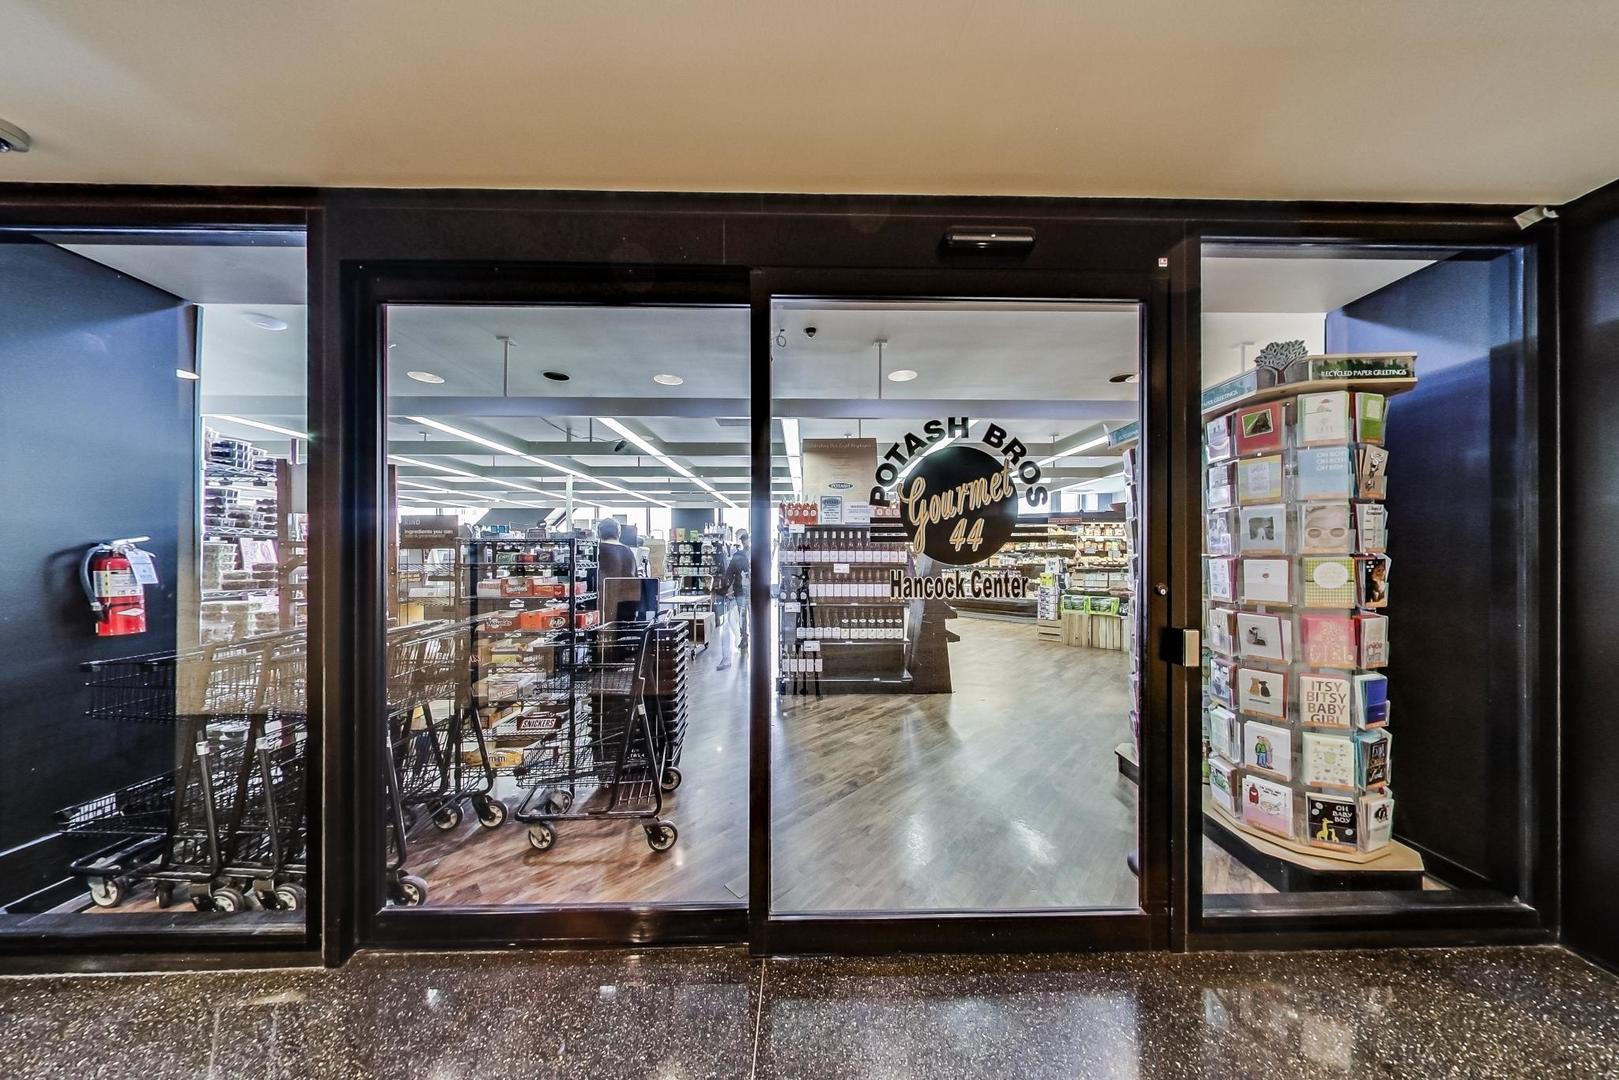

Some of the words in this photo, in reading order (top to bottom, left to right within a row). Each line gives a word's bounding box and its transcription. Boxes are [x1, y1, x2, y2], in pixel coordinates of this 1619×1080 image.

[869, 416, 969, 507] POTASH
[981, 422, 1048, 508] BROS
[897, 456, 1014, 554] Gourmet
[949, 517, 985, 552] 44
[889, 568, 965, 599] Hancock
[970, 569, 1029, 599] Center
[1311, 680, 1343, 692] ITSY
[1307, 691, 1347, 704] BITSY
[1307, 702, 1346, 715] BABY
[522, 718, 556, 729] SNICKERS
[1332, 810, 1353, 818] BABY
[1334, 816, 1351, 824] BOY
